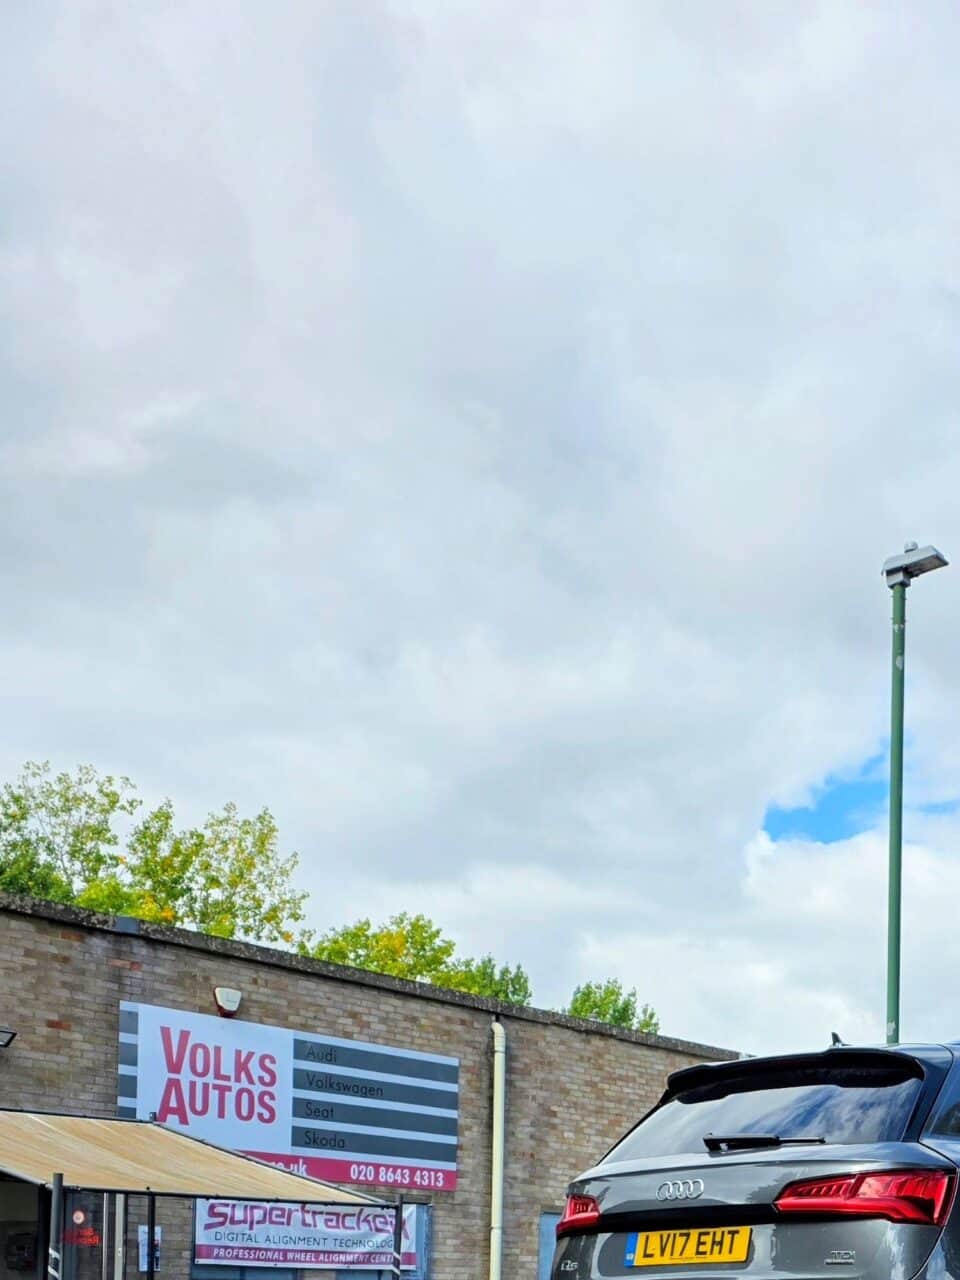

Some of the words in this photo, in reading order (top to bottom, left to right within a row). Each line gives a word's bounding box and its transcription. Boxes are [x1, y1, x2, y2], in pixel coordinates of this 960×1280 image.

[160, 1026, 276, 1087] VOLKS
[305, 1044, 337, 1063] Audi
[306, 1073, 384, 1097] Volkswagen
[157, 1077, 276, 1126] AUTOS
[305, 1102, 334, 1119] Seat
[304, 1130, 345, 1149] Skoda
[350, 1164, 375, 1181] 020
[379, 1168, 410, 1184] 8643
[414, 1171, 444, 1187] 4313
[215, 1231, 260, 1244] DIGITAL
[264, 1235, 328, 1248] ALIGNMENT
[333, 1238, 394, 1249] TECHNOLOG
[643, 1231, 690, 1258] LV17
[695, 1229, 740, 1256] EHT
[213, 1248, 284, 1261] PROFESSIONAL
[287, 1251, 315, 1262] WHEEL
[319, 1252, 368, 1264] ALIGNMENT
